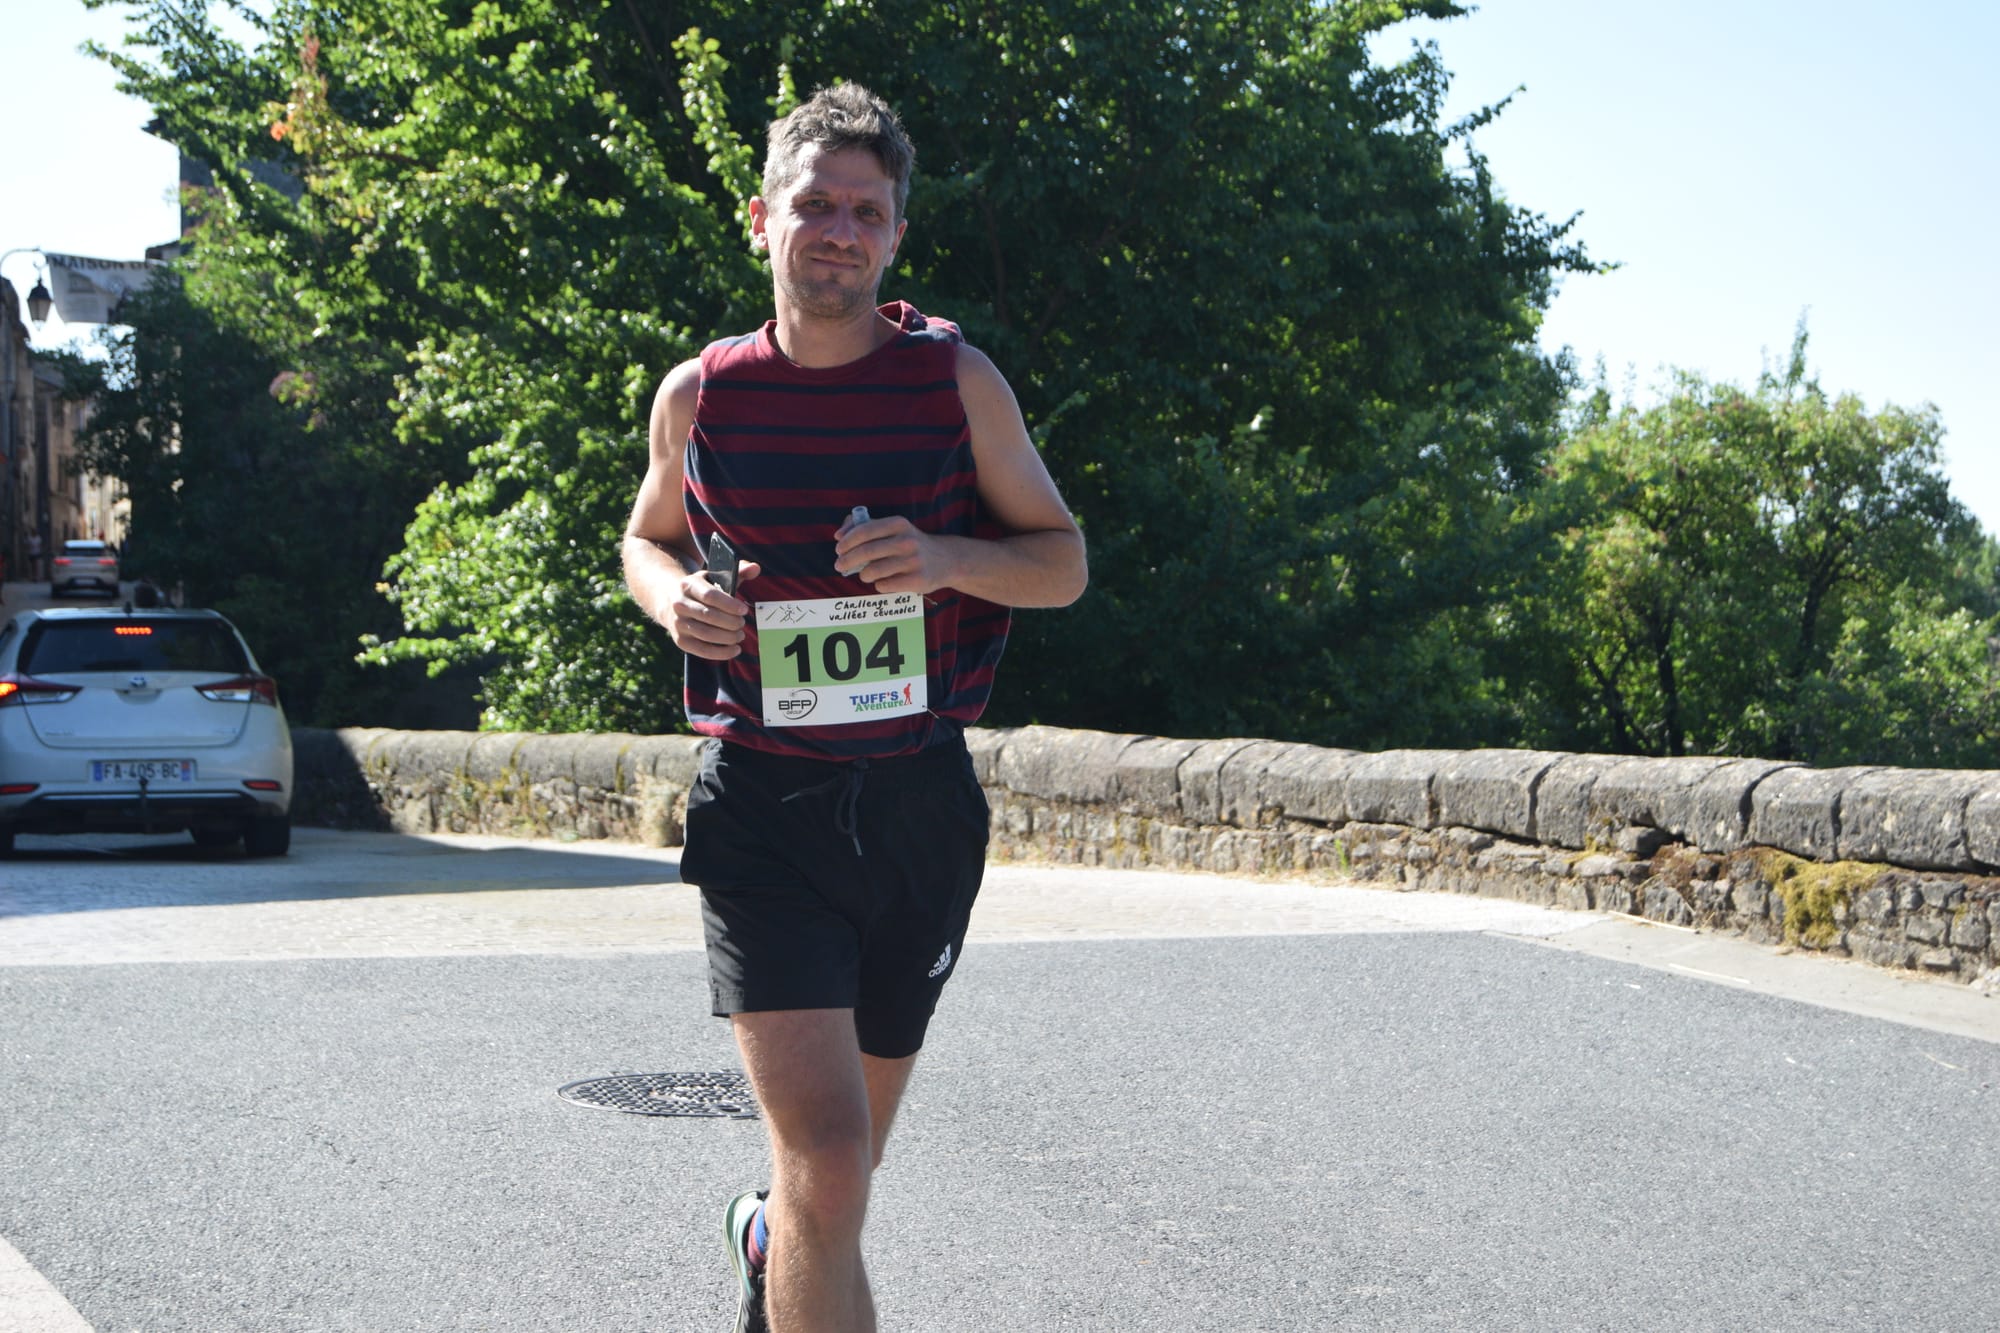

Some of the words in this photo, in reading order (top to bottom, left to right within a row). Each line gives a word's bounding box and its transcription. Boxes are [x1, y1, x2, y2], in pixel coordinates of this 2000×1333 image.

[834, 599, 889, 611] Challenge
[894, 595, 911, 605] des
[829, 610, 867, 621] vallées
[873, 604, 917, 617] cévenoles
[783, 626, 905, 683] 104
[778, 699, 812, 710] BFP
[849, 690, 899, 706] TUFF'S
[854, 699, 904, 712] Aventure
